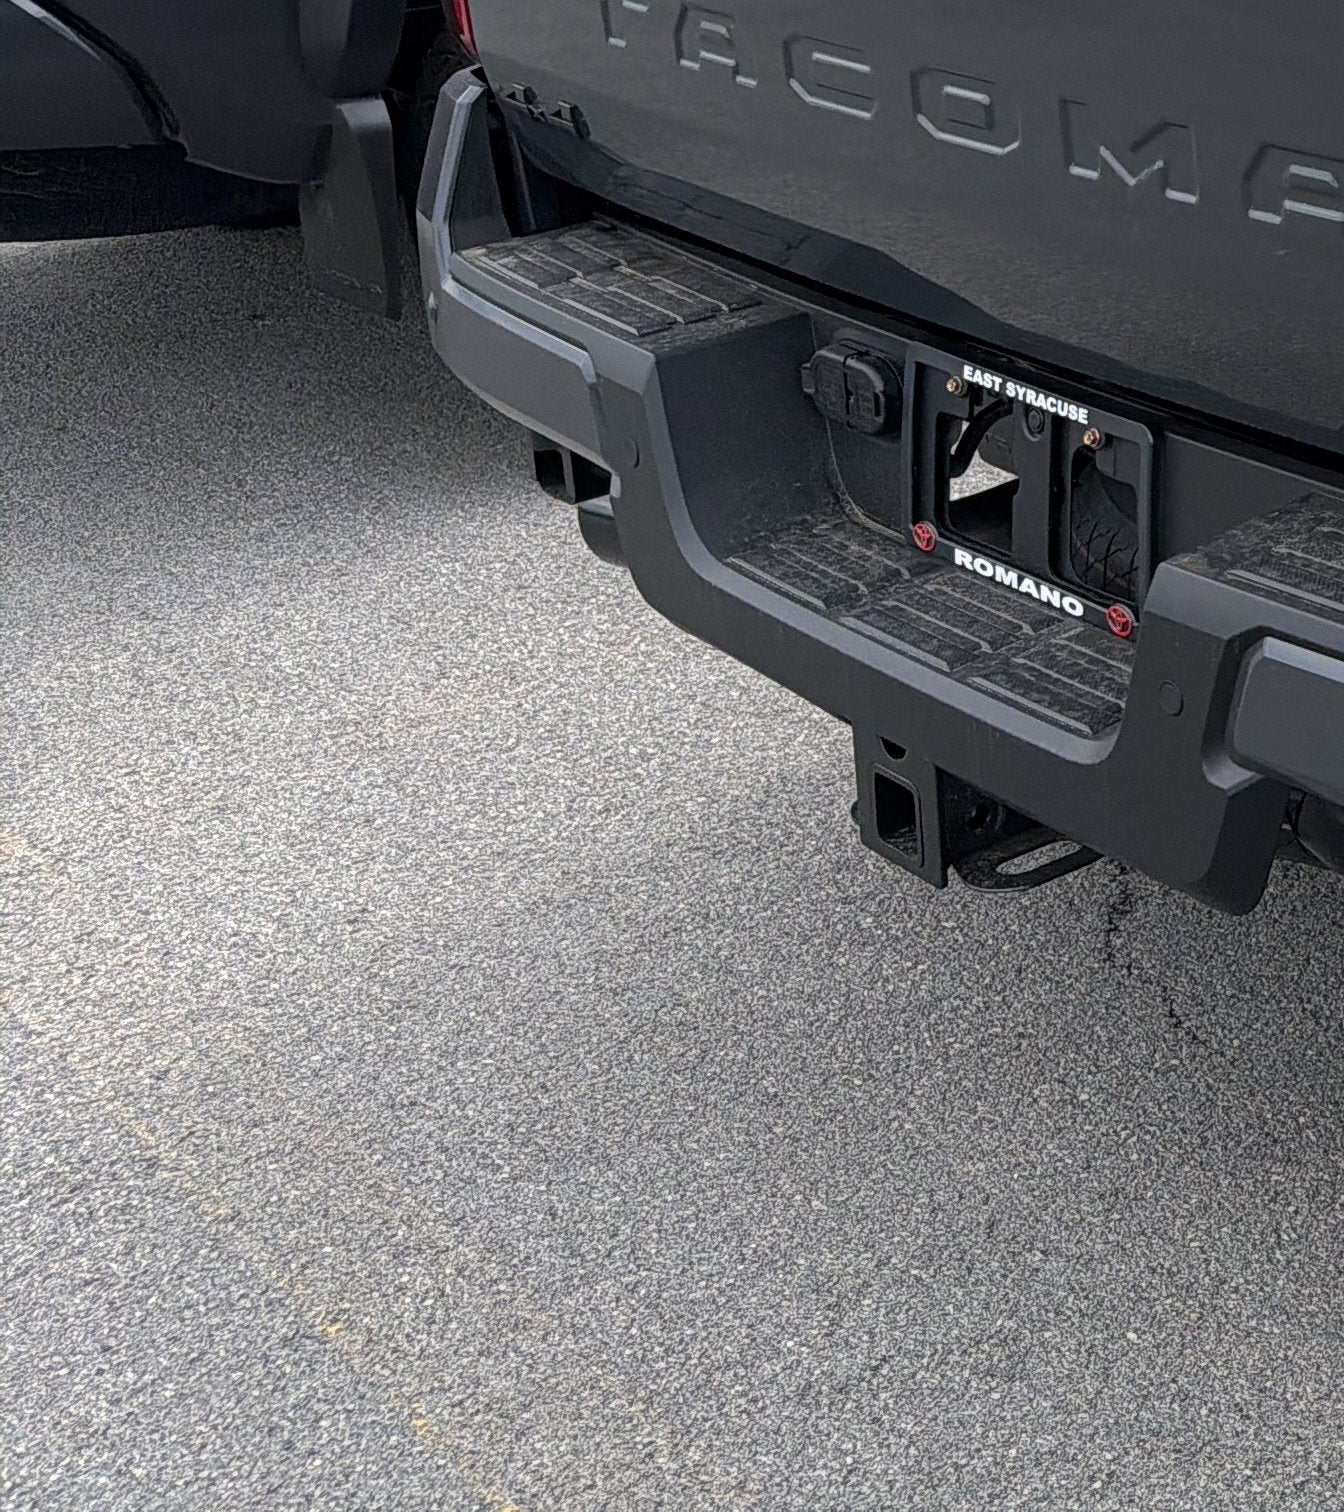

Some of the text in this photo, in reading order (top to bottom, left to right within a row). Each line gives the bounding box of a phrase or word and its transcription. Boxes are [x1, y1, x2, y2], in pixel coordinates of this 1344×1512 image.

[962, 364, 1089, 425] EAST SYRACUSE
[954, 548, 1085, 617] ROMANO
